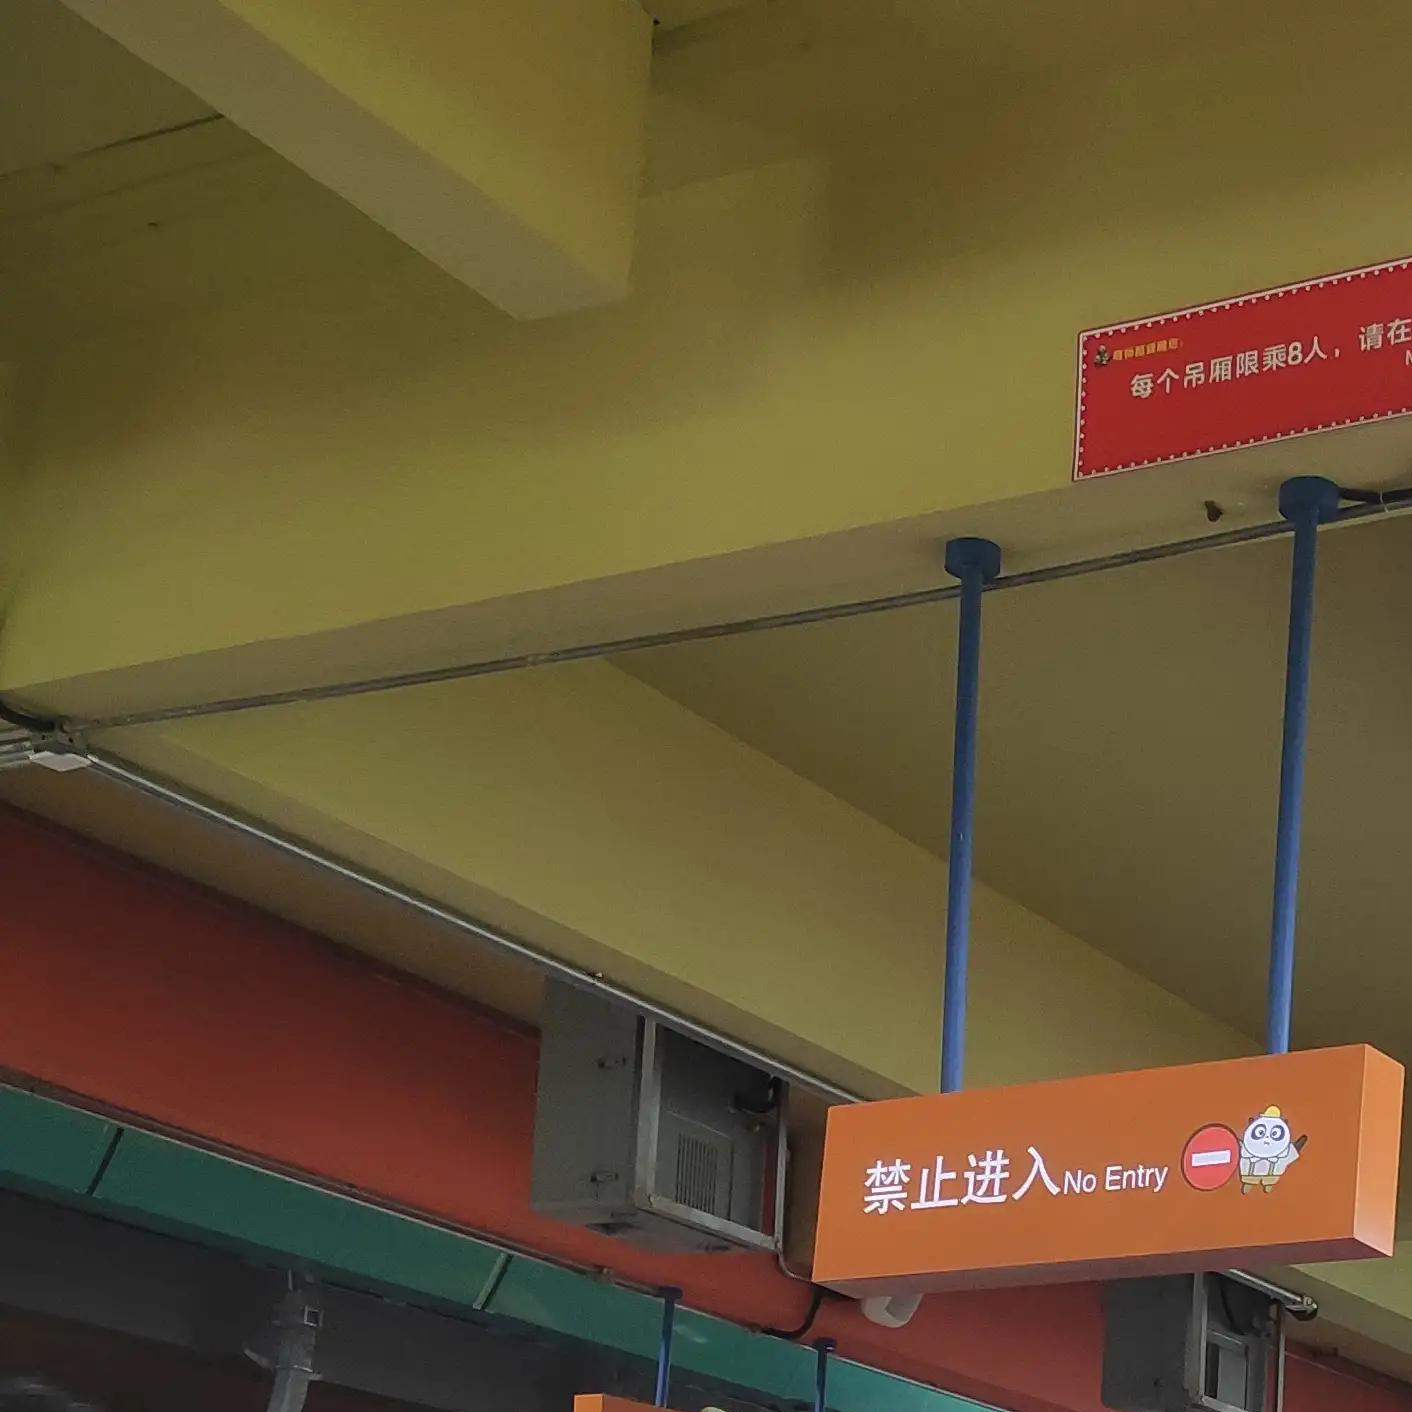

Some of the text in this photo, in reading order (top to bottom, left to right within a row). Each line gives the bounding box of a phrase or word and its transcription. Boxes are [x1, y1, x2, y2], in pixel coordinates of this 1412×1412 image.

[863, 1146, 1169, 1216] 禁止进入 No Entry
